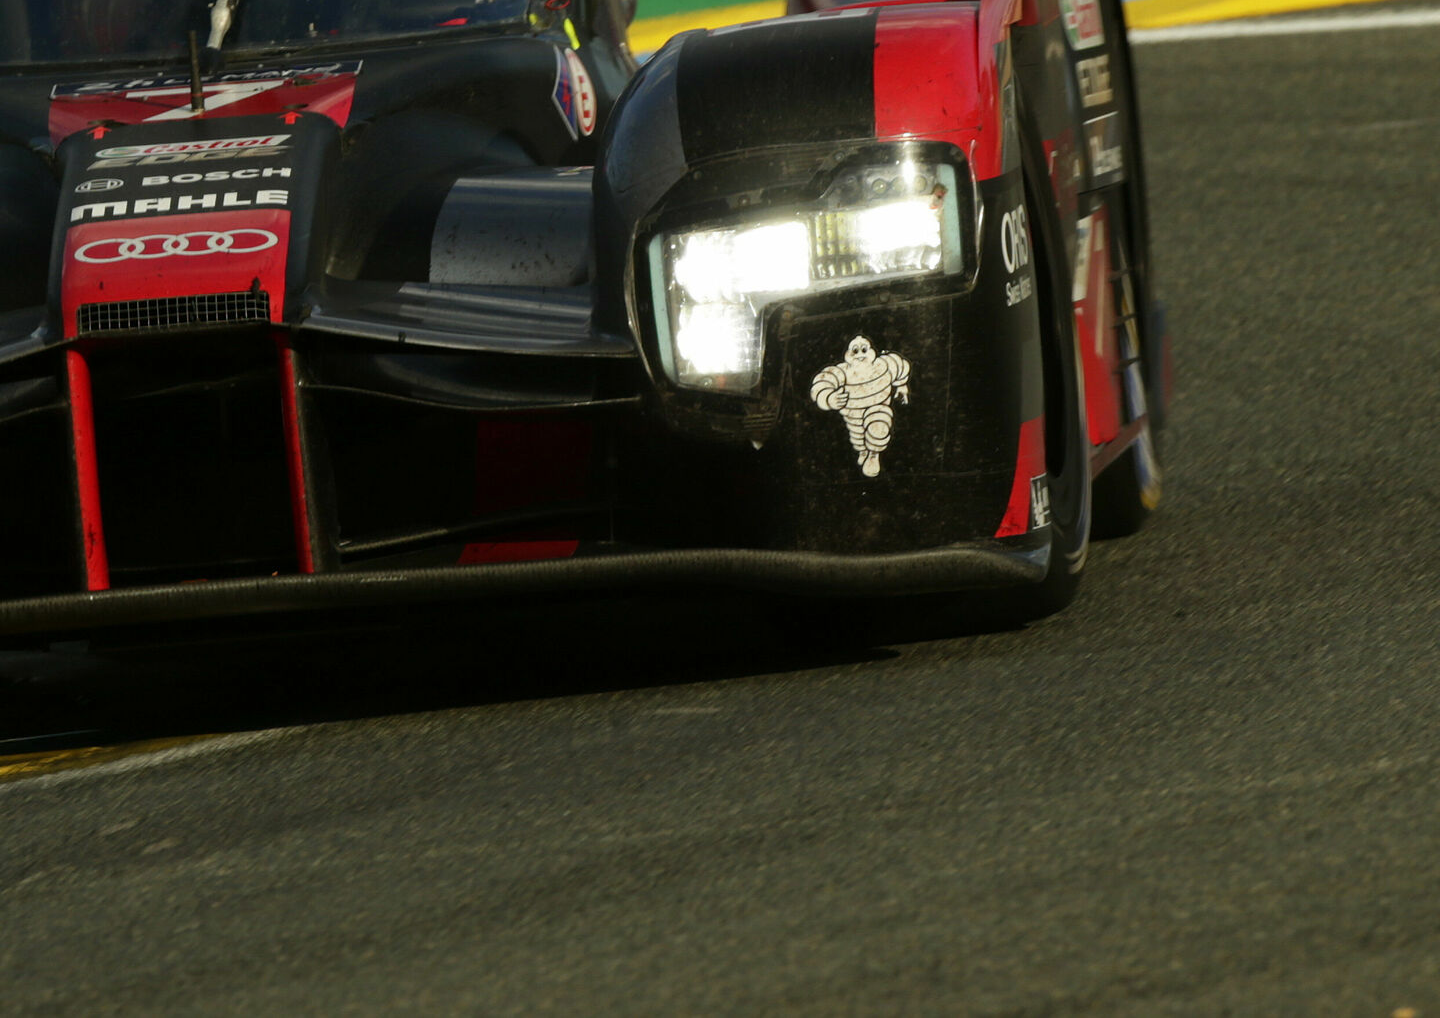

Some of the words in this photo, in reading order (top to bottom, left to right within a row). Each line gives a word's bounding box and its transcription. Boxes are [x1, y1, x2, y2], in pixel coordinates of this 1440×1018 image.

[142, 136, 276, 155] Castrol
[86, 145, 293, 171] EDGE
[141, 167, 292, 187] BOSCH
[70, 189, 289, 222] MAHLE
